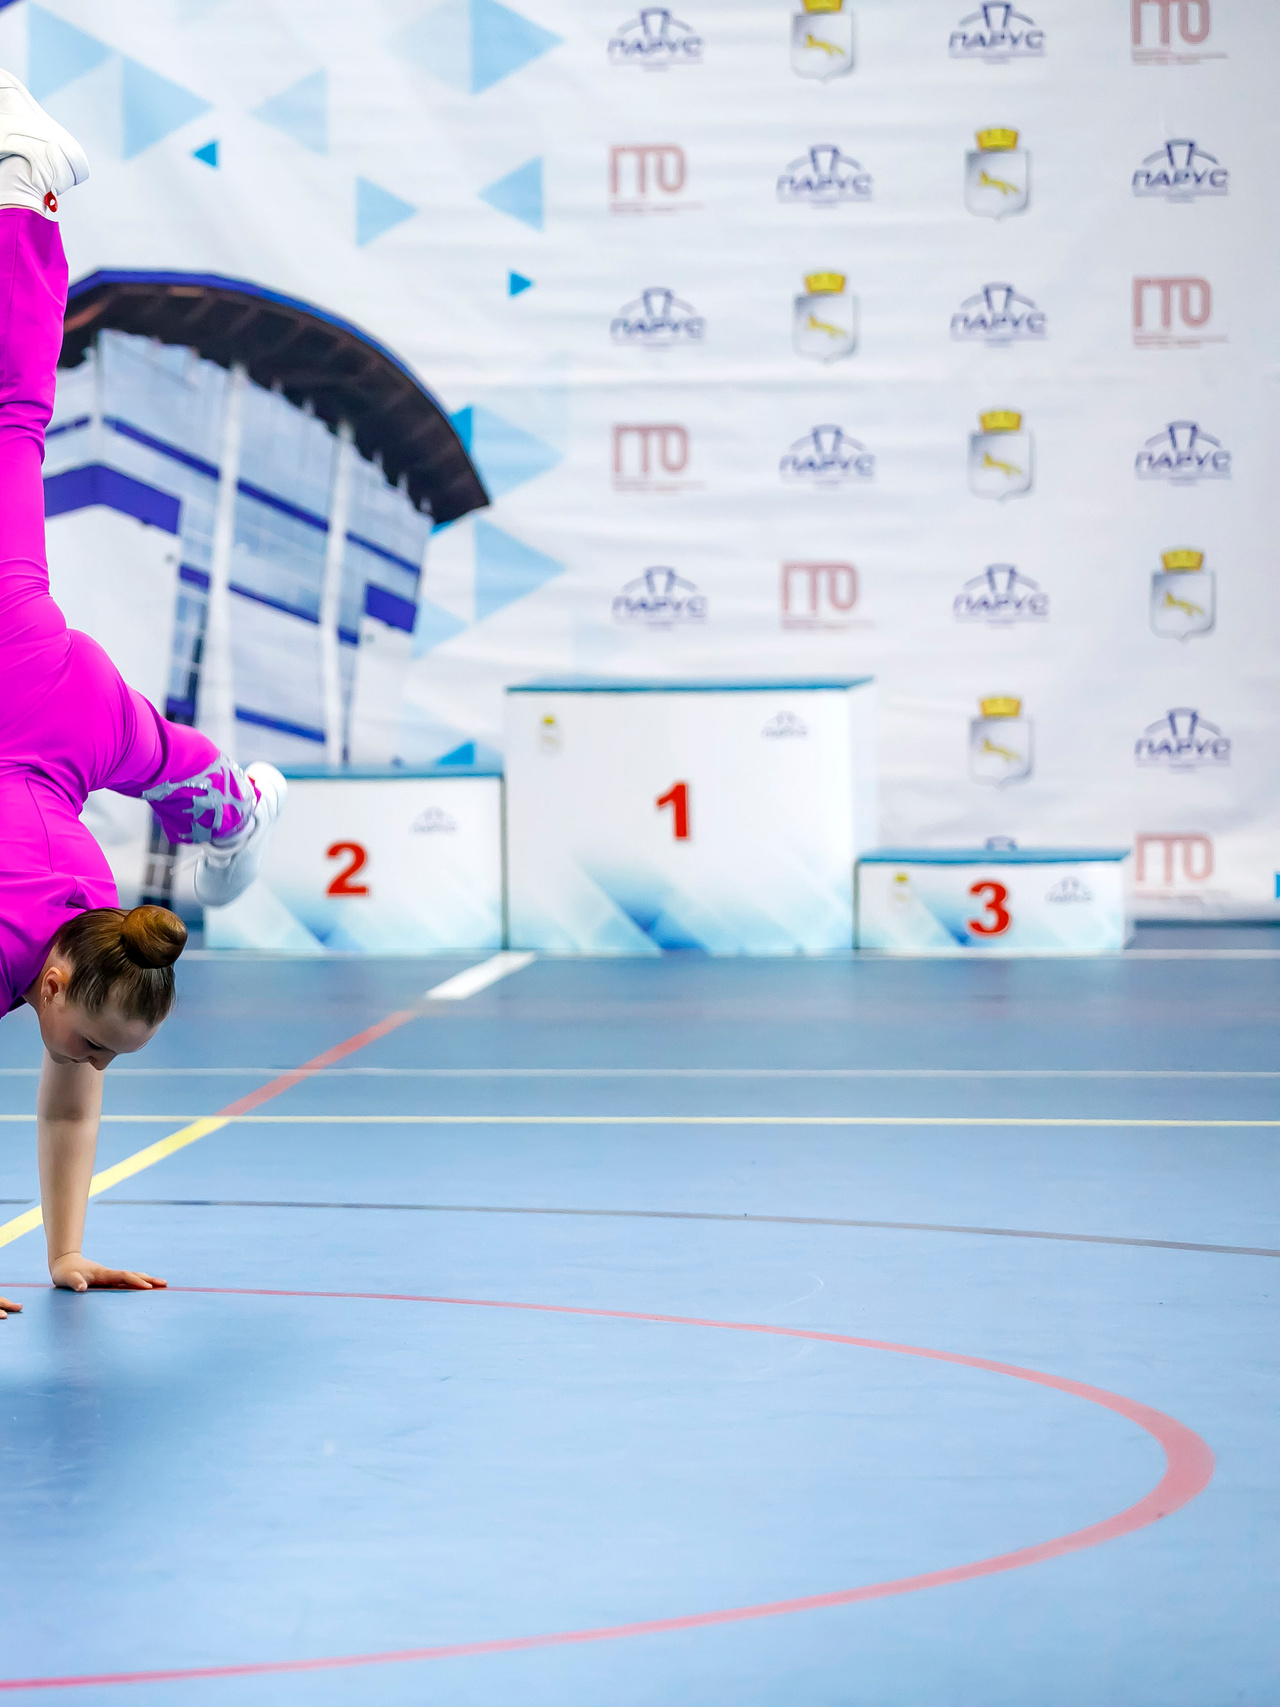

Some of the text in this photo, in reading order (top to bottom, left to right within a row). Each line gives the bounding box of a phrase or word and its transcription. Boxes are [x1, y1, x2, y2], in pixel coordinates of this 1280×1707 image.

[655, 782, 690, 840] 1
[326, 841, 370, 896] 2
[968, 880, 1012, 937] 3
